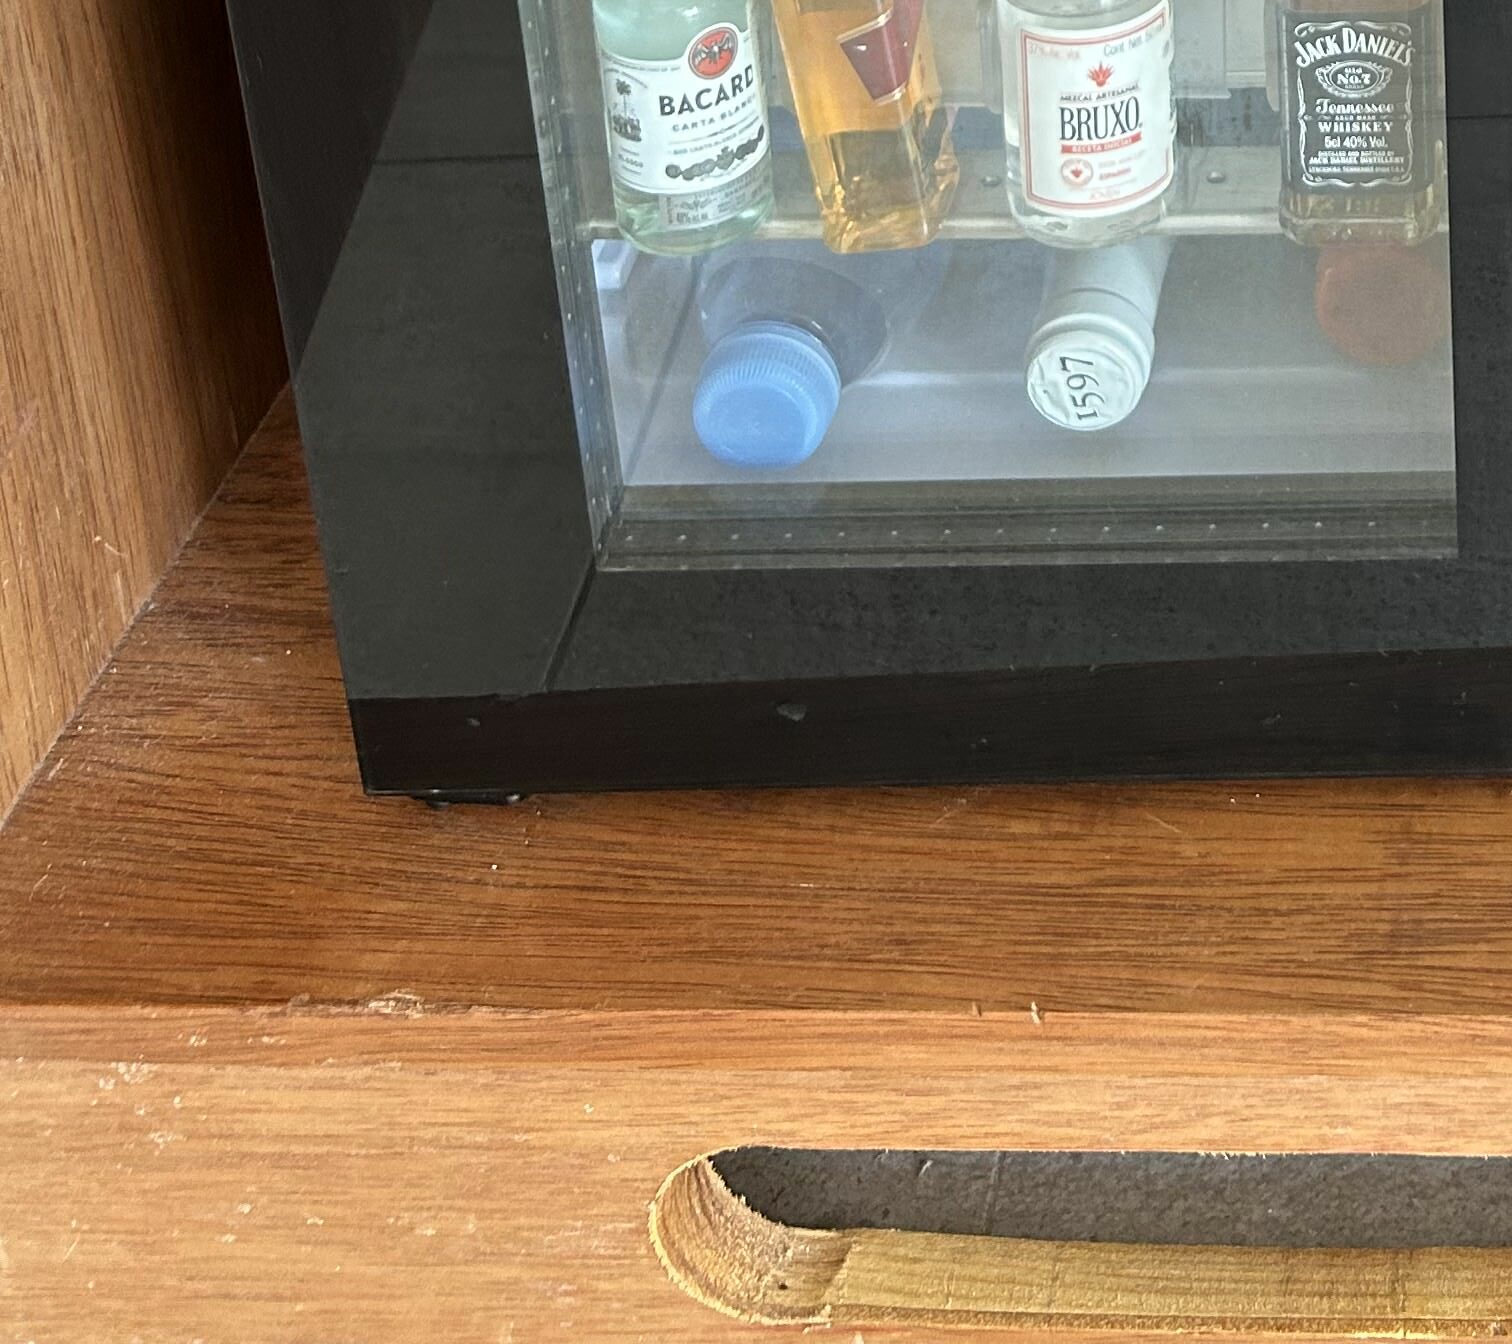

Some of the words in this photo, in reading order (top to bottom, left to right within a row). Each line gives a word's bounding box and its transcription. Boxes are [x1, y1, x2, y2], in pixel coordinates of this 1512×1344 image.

[1294, 34, 1342, 67] JACK
[1341, 27, 1416, 67] DANIEL'S
[659, 64, 754, 117] BACARD
[1059, 96, 1140, 142] BRUXO
[1315, 98, 1395, 114] Tennessee
[672, 117, 715, 133] CARTA
[1318, 121, 1394, 133] WHISKEY
[1324, 135, 1341, 149] 5cl
[1343, 135, 1367, 149] 40%
[1369, 136, 1389, 149] Vol.
[1059, 356, 1105, 421] 1597
